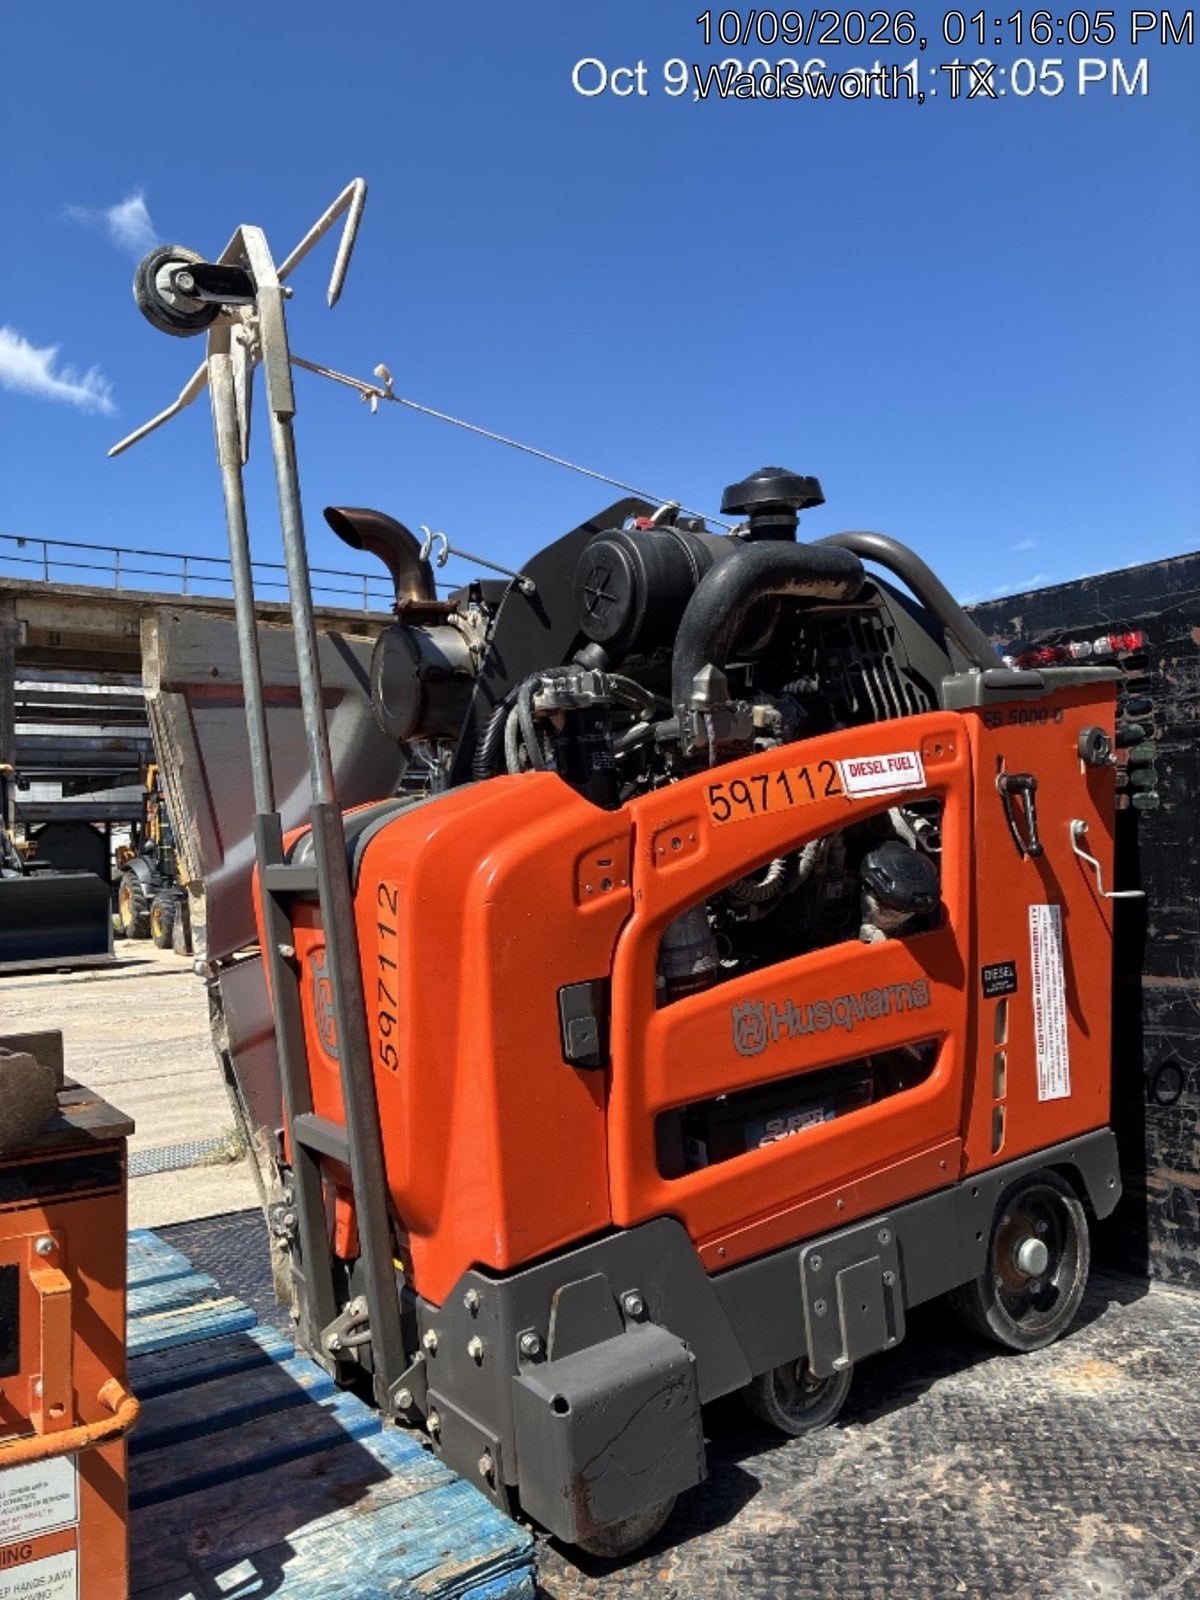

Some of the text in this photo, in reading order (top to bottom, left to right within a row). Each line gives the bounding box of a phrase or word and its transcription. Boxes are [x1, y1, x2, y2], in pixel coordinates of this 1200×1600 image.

[850, 755, 914, 778] DIESEL FUEL
[707, 760, 842, 822] 597112
[377, 882, 399, 1072] 597112
[984, 966, 1015, 981] DIESEL
[770, 980, 929, 1040] Husqvarna
[1034, 997, 1045, 1055] CUSTOMER
[0, 1544, 33, 1566] ING
[13, 1575, 45, 1594] HANDS
